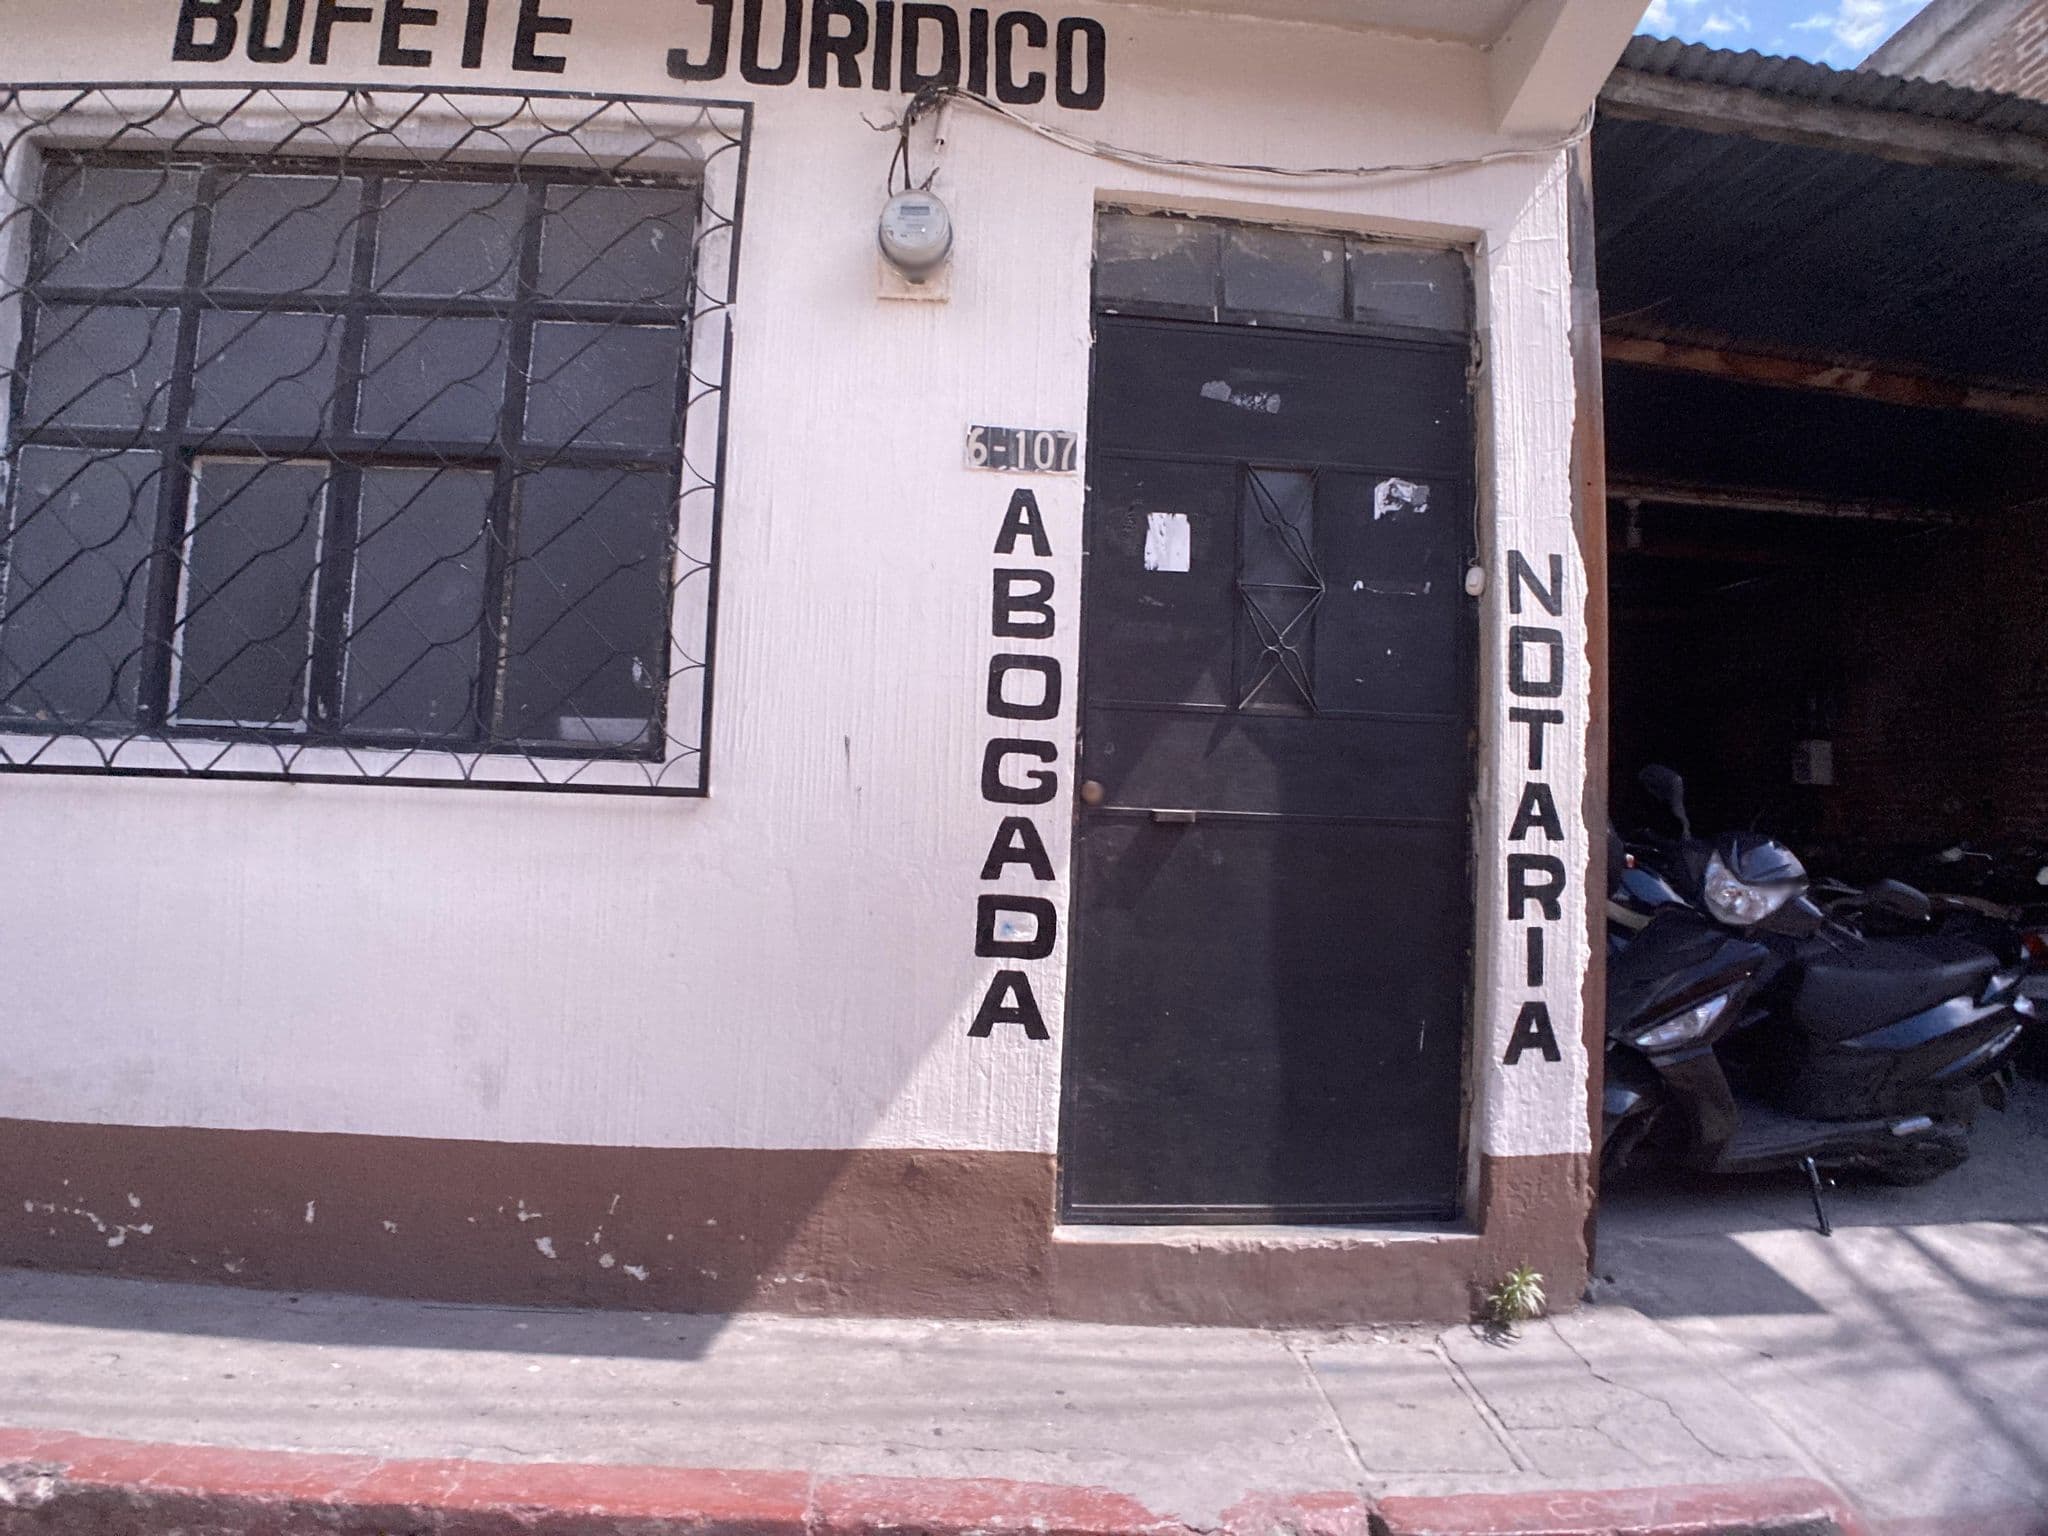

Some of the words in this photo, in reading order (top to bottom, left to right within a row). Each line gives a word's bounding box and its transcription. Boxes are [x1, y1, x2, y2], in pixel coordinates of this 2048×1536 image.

[667, 0, 1107, 111] JURIDICO
[967, 426, 1078, 470] 6-107
[967, 488, 1062, 1041] ABOGADA
[1503, 549, 1566, 1066] NOTARIA
